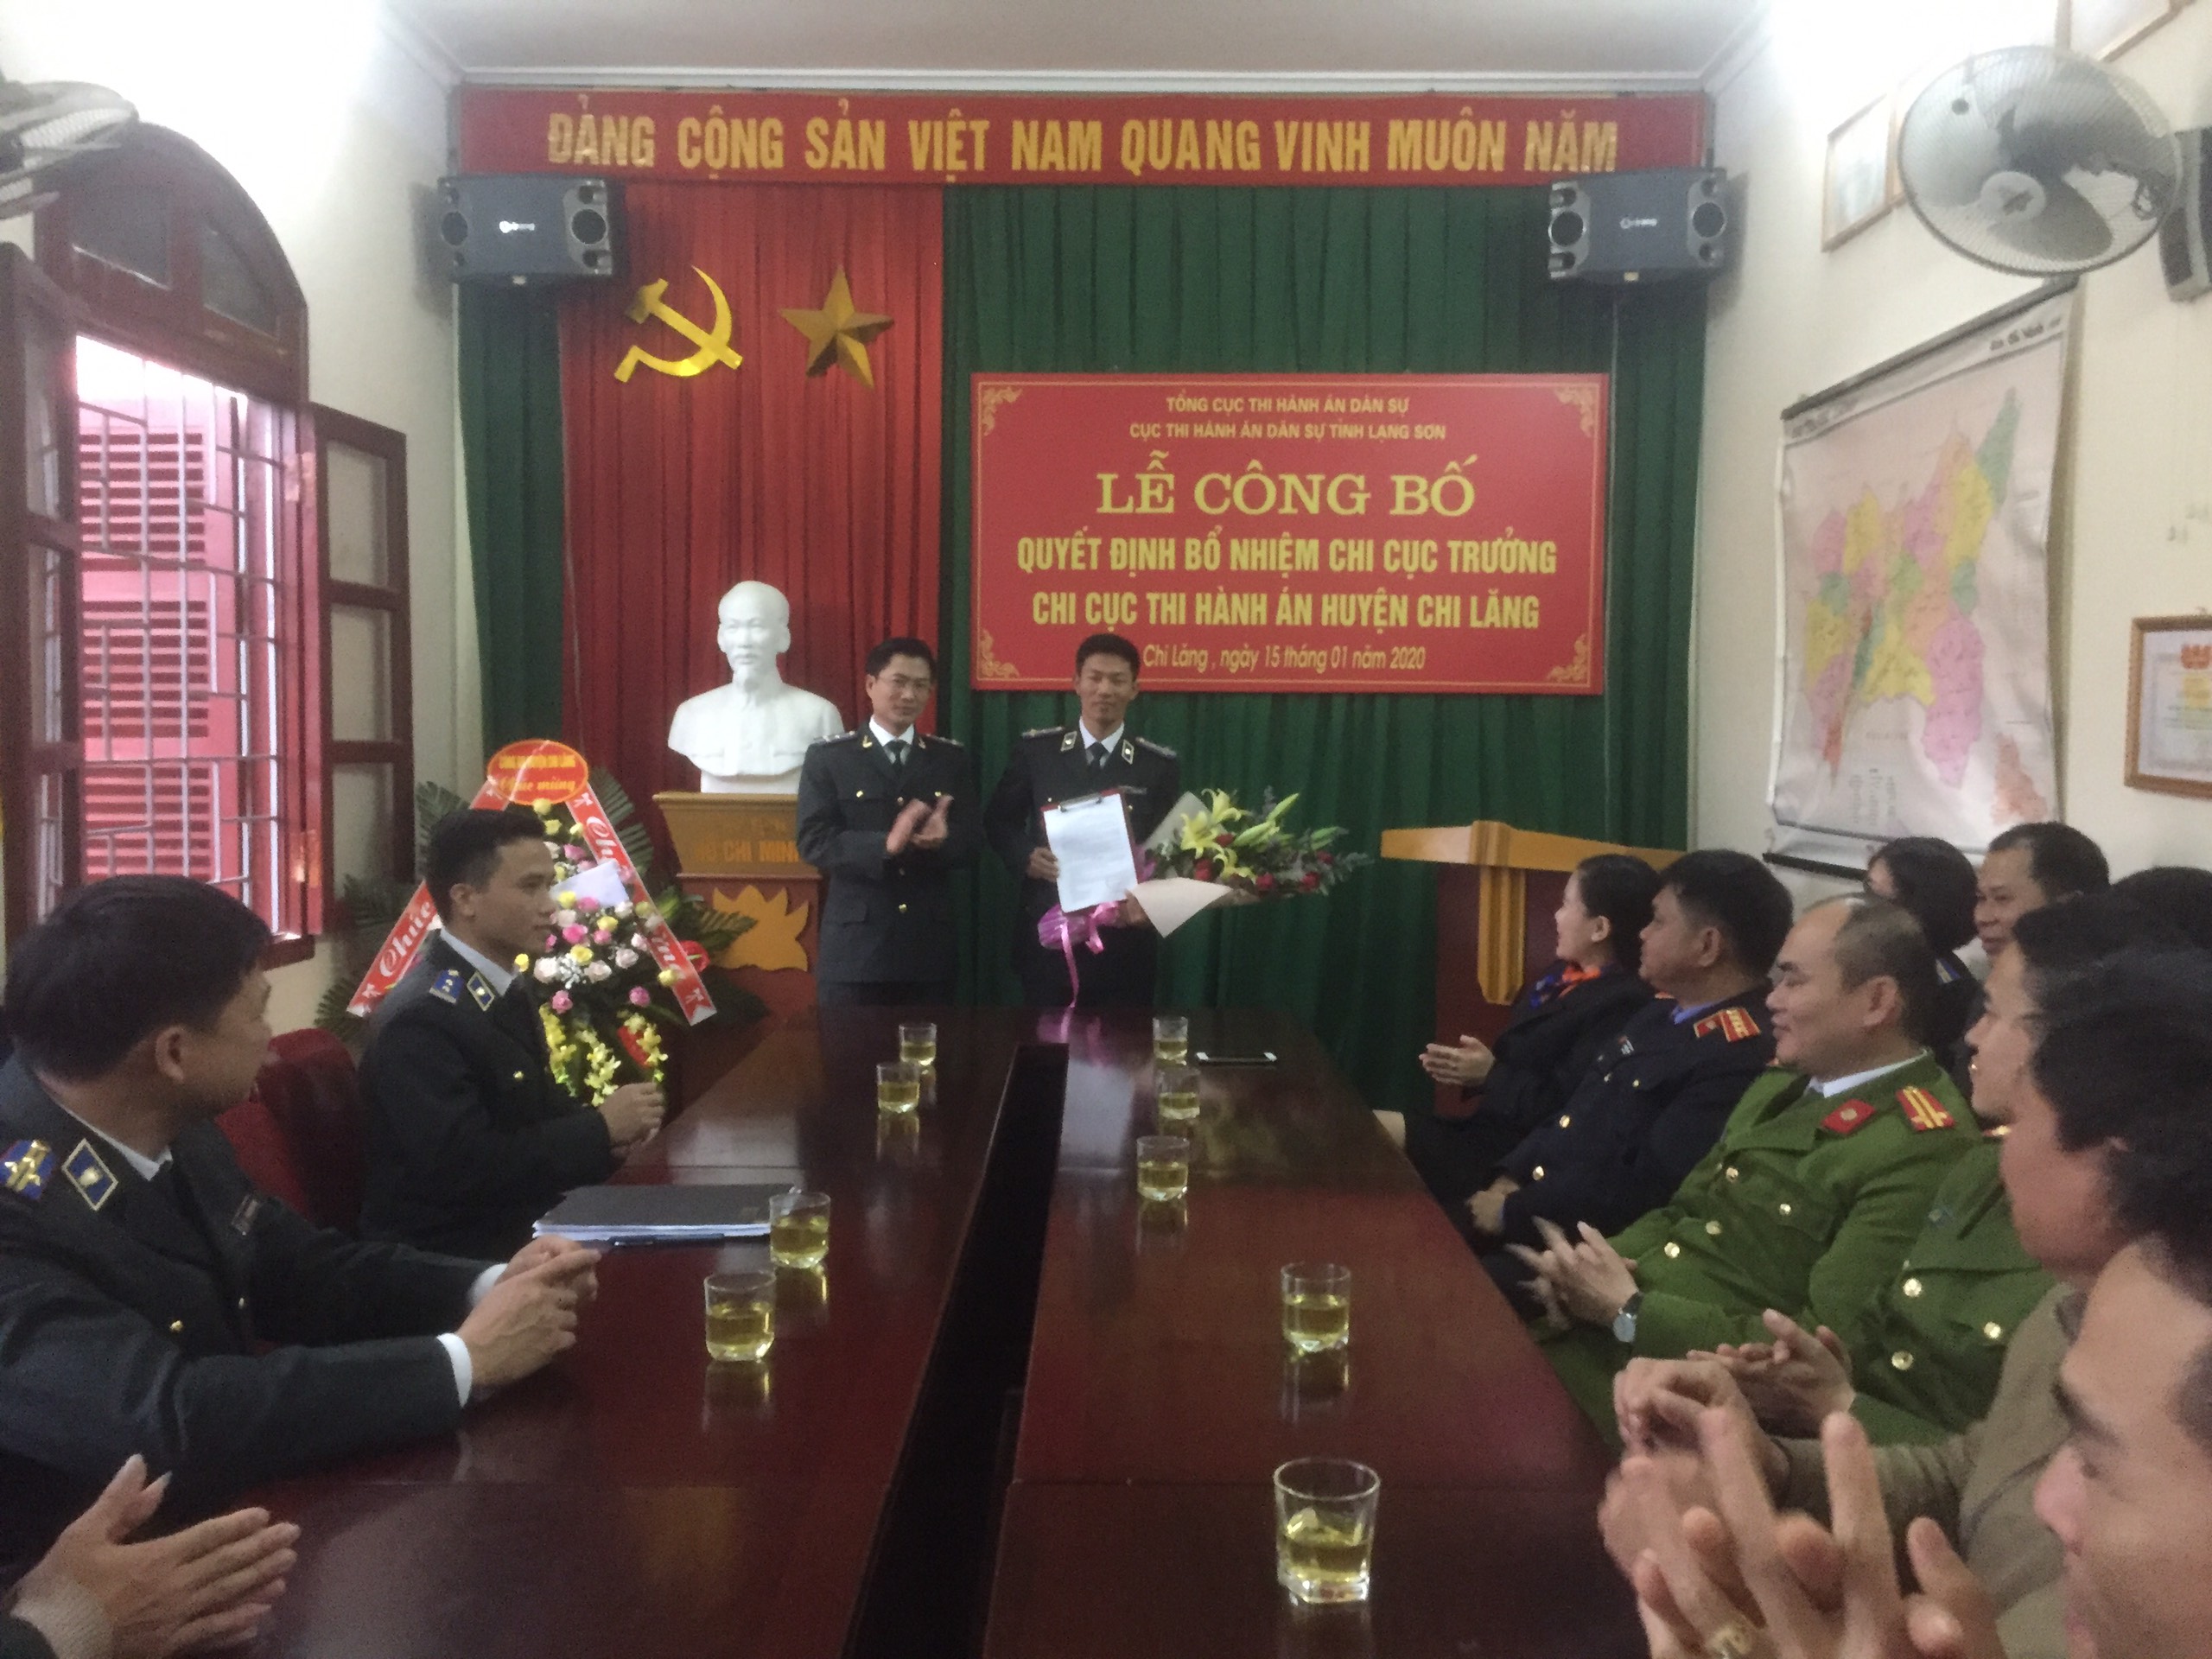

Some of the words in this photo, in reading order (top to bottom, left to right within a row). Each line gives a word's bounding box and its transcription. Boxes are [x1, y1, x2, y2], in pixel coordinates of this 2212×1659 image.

[548, 94, 655, 168] ĐẢNG
[678, 105, 784, 180] CỘNG
[805, 98, 887, 170] SẢN
[909, 109, 990, 183] VIỆT
[1012, 120, 1102, 171] NAM
[1121, 118, 1261, 175] QUANG
[1274, 120, 1370, 171] VINH
[1388, 106, 1505, 172] MUÔN
[1524, 109, 1618, 173] NĂM
[1166, 389, 1208, 412] TỔNG
[1212, 397, 1244, 416] CỤC
[1249, 397, 1272, 412] THI
[1277, 394, 1319, 413] HÀNH
[1325, 394, 1345, 413] ÁN
[1350, 394, 1382, 413] DÂN
[1388, 396, 1410, 418] SỰ
[1129, 423, 1161, 442] CỤC
[1167, 423, 1189, 438] THI
[1192, 420, 1236, 438] HÀNH
[1304, 423, 1325, 442] SỰ
[1330, 418, 1364, 439] TỈNH
[1369, 423, 1410, 442] LẠNG
[1414, 423, 1446, 440] SƠN
[1096, 449, 1175, 514] LỄ
[1194, 459, 1371, 515] CÔNG
[1389, 454, 1478, 517] BỐ
[1017, 525, 1102, 574] QUYẾT
[1109, 537, 1175, 578] ĐỊNH
[1185, 524, 1223, 571] BỔ
[1230, 531, 1319, 578] NHIỆM
[1329, 538, 1374, 572] CHI
[1383, 539, 1438, 580] CỤC
[1447, 526, 1557, 574] TRƯỞNG
[1032, 592, 1077, 625] CHI
[1085, 592, 1137, 632] CỤC
[1146, 593, 1186, 625] THI
[1195, 586, 1268, 626] HÀNH
[1275, 586, 1313, 626] ÁN
[1320, 587, 1408, 634] HUYỆN
[1417, 594, 1461, 628] CHI
[1470, 588, 1540, 629] LĂNG
[1142, 645, 1167, 668] Chi
[1220, 643, 1258, 673] ngày
[1265, 645, 1281, 668] 15
[1284, 644, 1327, 674] tháng
[1331, 645, 1348, 669] 01
[1352, 645, 1386, 669] năm
[1389, 646, 1426, 670] 2020
